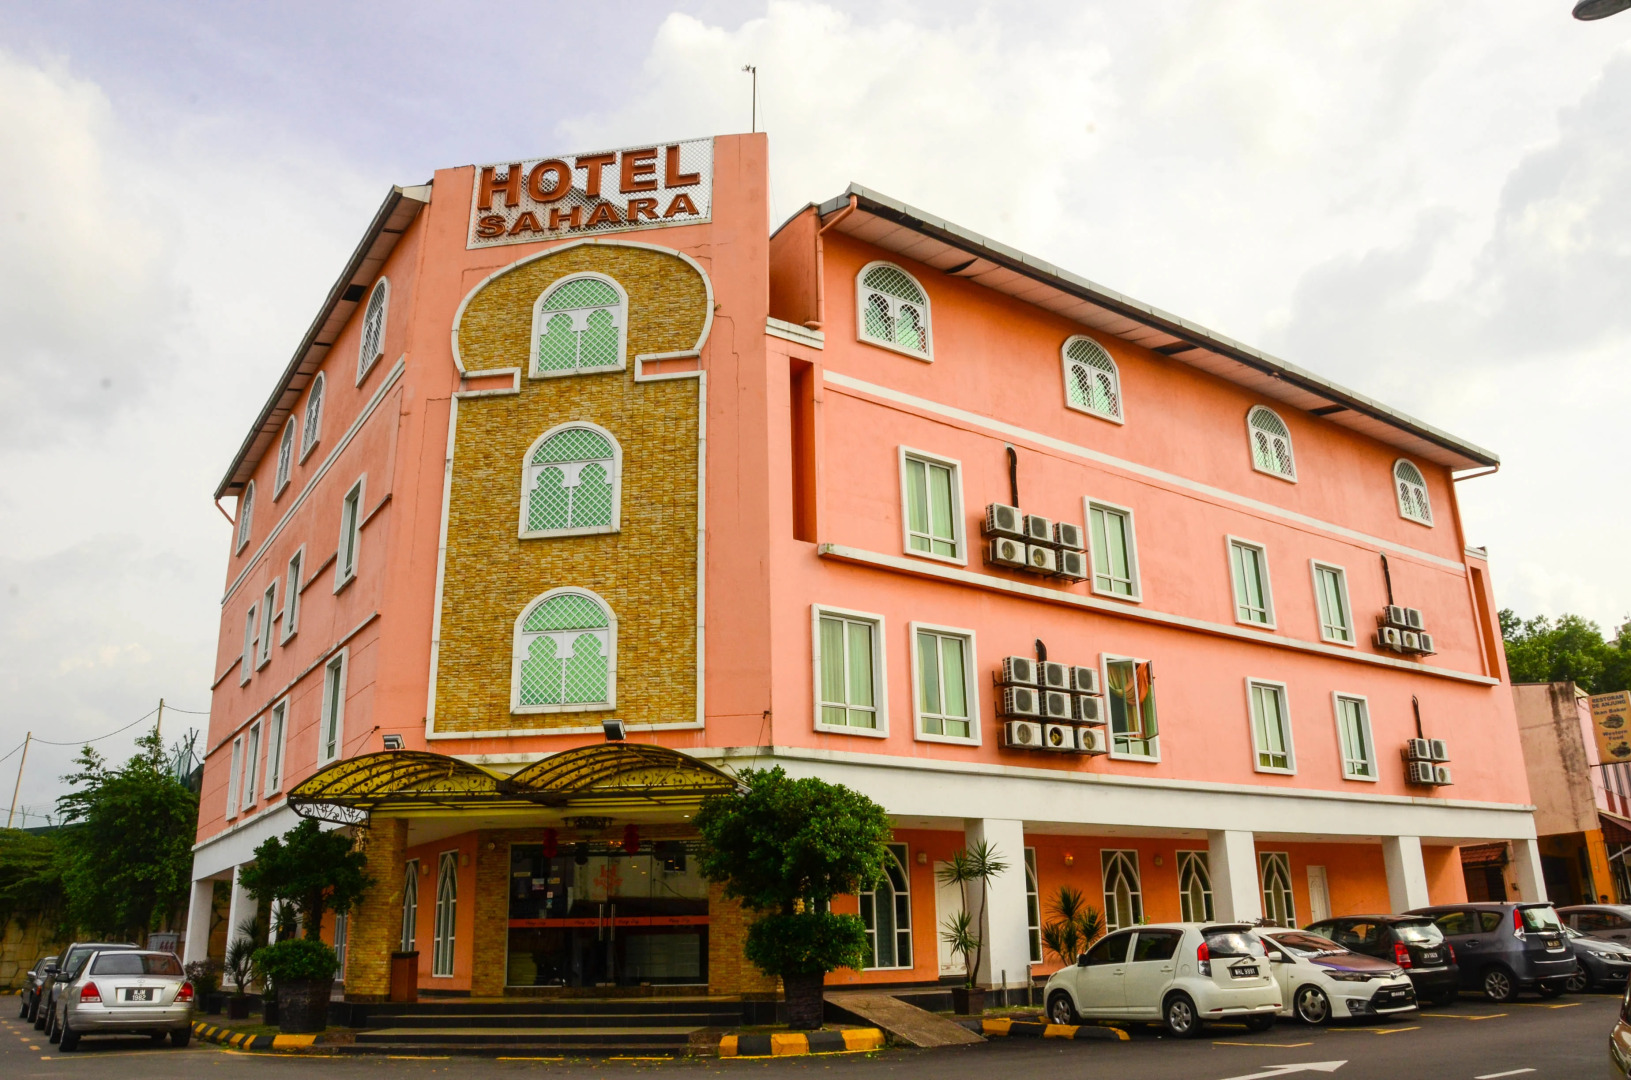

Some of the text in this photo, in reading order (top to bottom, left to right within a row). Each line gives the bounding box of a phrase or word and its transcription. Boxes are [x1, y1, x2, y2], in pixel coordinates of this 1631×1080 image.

[477, 145, 701, 210] HOTEL
[476, 193, 700, 238] SAHARA
[1592, 694, 1624, 703] RESTORAN
